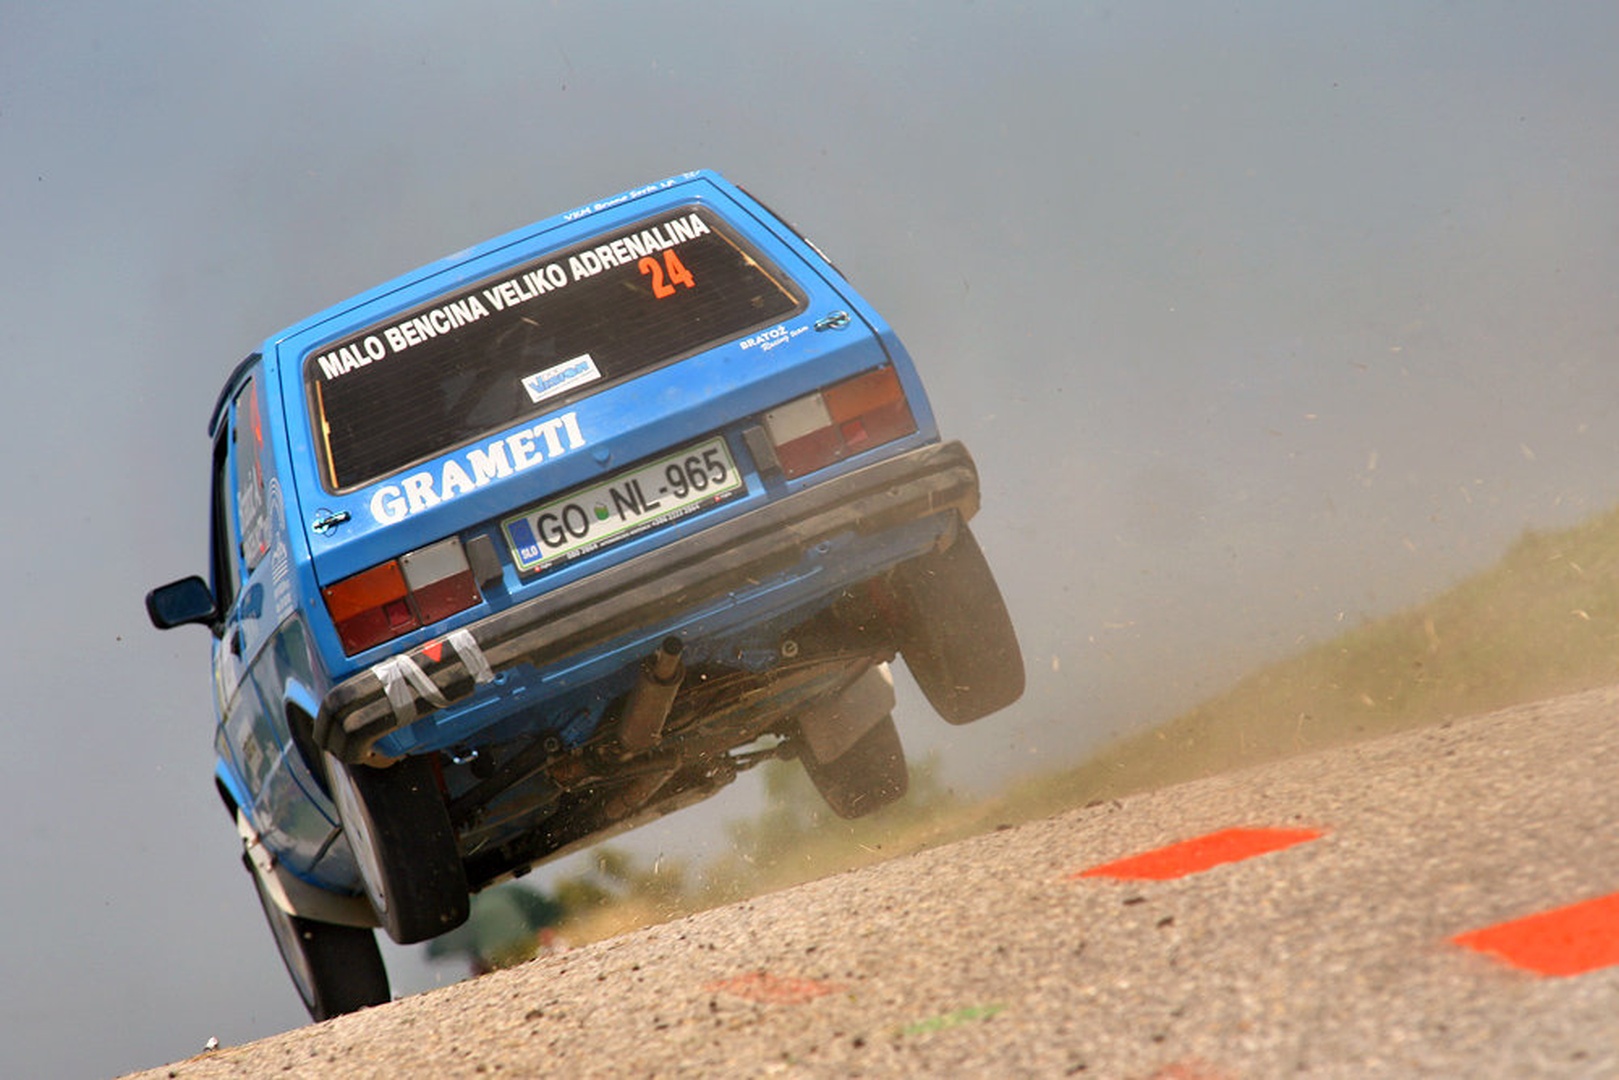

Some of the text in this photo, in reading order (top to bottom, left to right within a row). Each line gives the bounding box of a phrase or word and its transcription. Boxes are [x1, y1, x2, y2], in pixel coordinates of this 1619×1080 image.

[317, 213, 711, 381] MALO BENCINA VELIKO ADRENALINA
[638, 249, 696, 299] 24
[370, 411, 587, 527] GRAMETI
[537, 503, 589, 548] GO
[609, 448, 728, 521] NL-965
[521, 545, 539, 560] SLO
